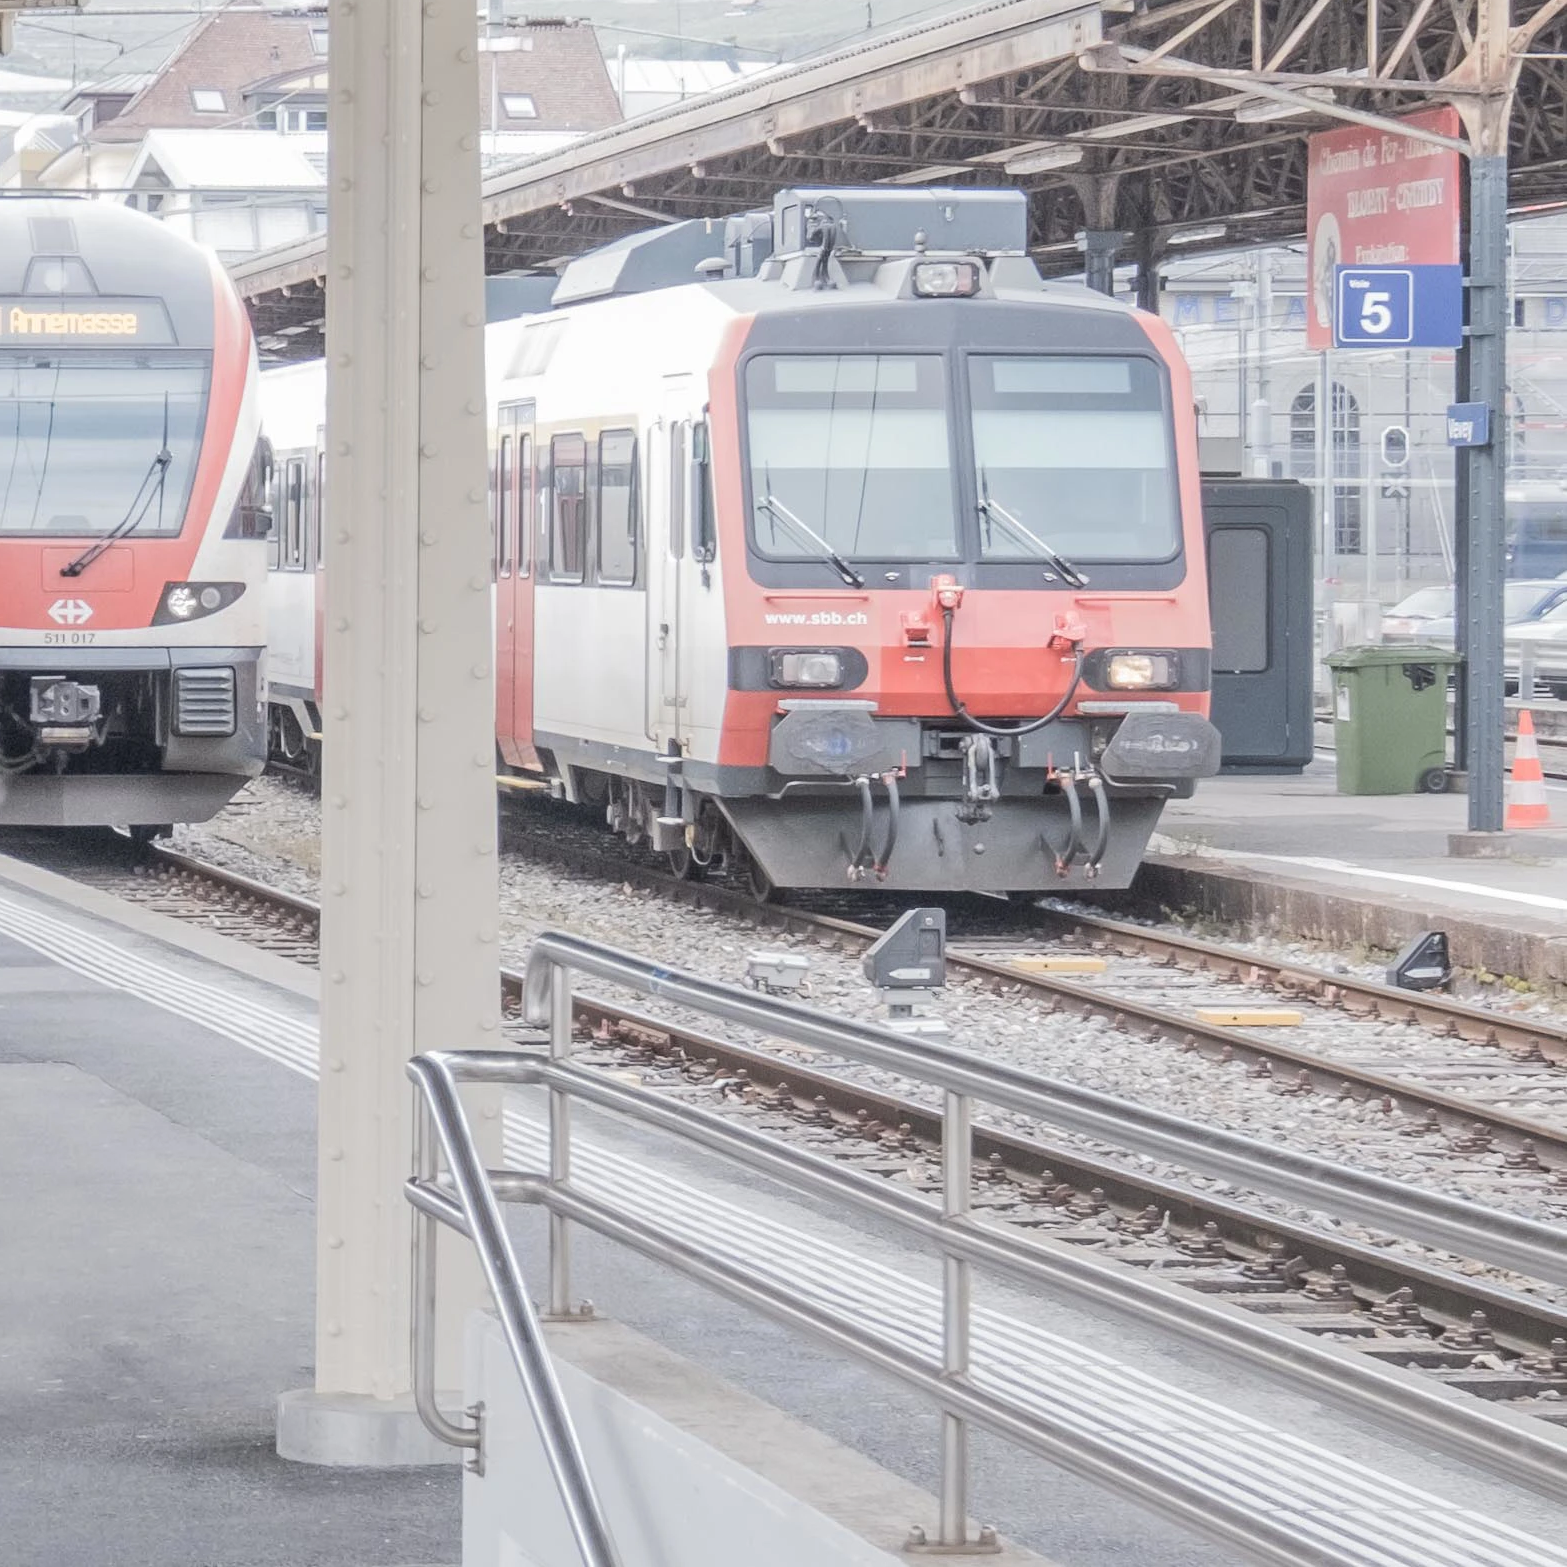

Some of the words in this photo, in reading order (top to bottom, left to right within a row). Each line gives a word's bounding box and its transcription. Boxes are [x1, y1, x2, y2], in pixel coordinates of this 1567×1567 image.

[1360, 292, 1392, 334] 5
[765, 612, 868, 625] www.sbb.ch
[44, 632, 66, 645] 511
[71, 632, 96, 645] 017
